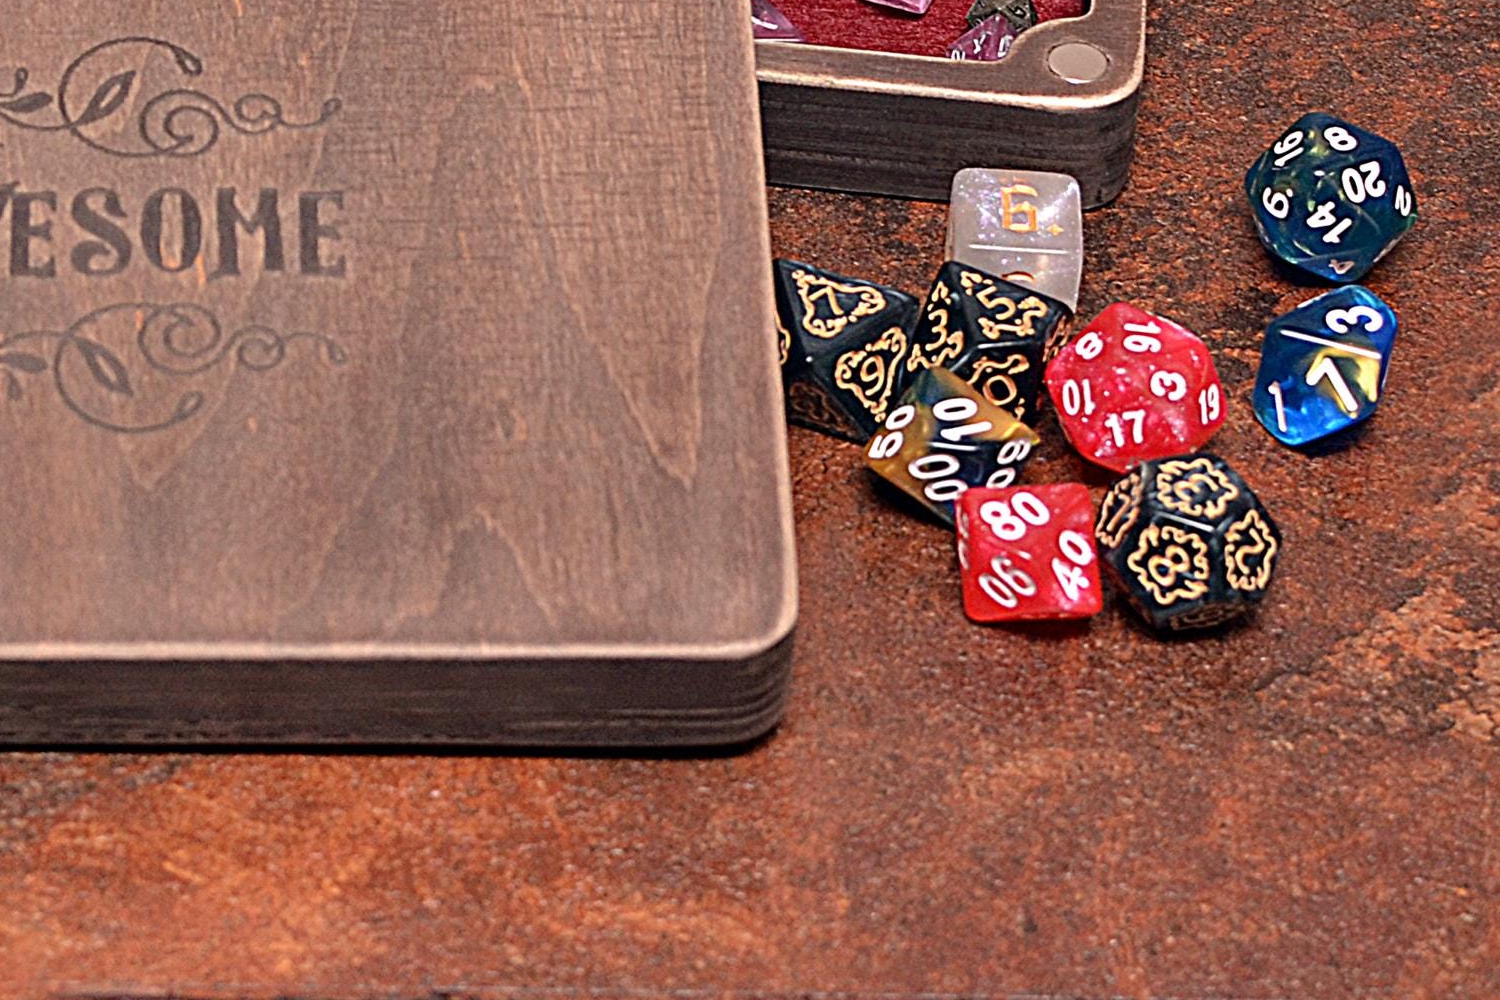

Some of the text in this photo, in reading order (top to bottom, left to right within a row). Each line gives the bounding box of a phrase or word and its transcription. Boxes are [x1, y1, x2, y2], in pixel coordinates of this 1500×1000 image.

[1274, 131, 1305, 168] 16
[1323, 126, 1358, 151] 8
[1342, 160, 1386, 204] 20
[1306, 200, 1352, 244] 14
[976, 285, 1017, 321] 5
[1325, 304, 1384, 335] 3
[925, 308, 949, 352] 3
[1075, 331, 1105, 360] 8
[1123, 321, 1162, 353] 16
[1150, 370, 1187, 401] 3
[1199, 383, 1221, 424] 19
[1267, 379, 1287, 434] 1
[1305, 356, 1359, 413] 7
[868, 404, 916, 459] 50
[932, 397, 993, 441] 10
[1104, 409, 1145, 448] 17
[908, 454, 969, 502] 00
[980, 491, 1050, 540] 80
[1051, 529, 1093, 601] 40
[1148, 545, 1190, 587] 8
[1235, 528, 1265, 574] 2
